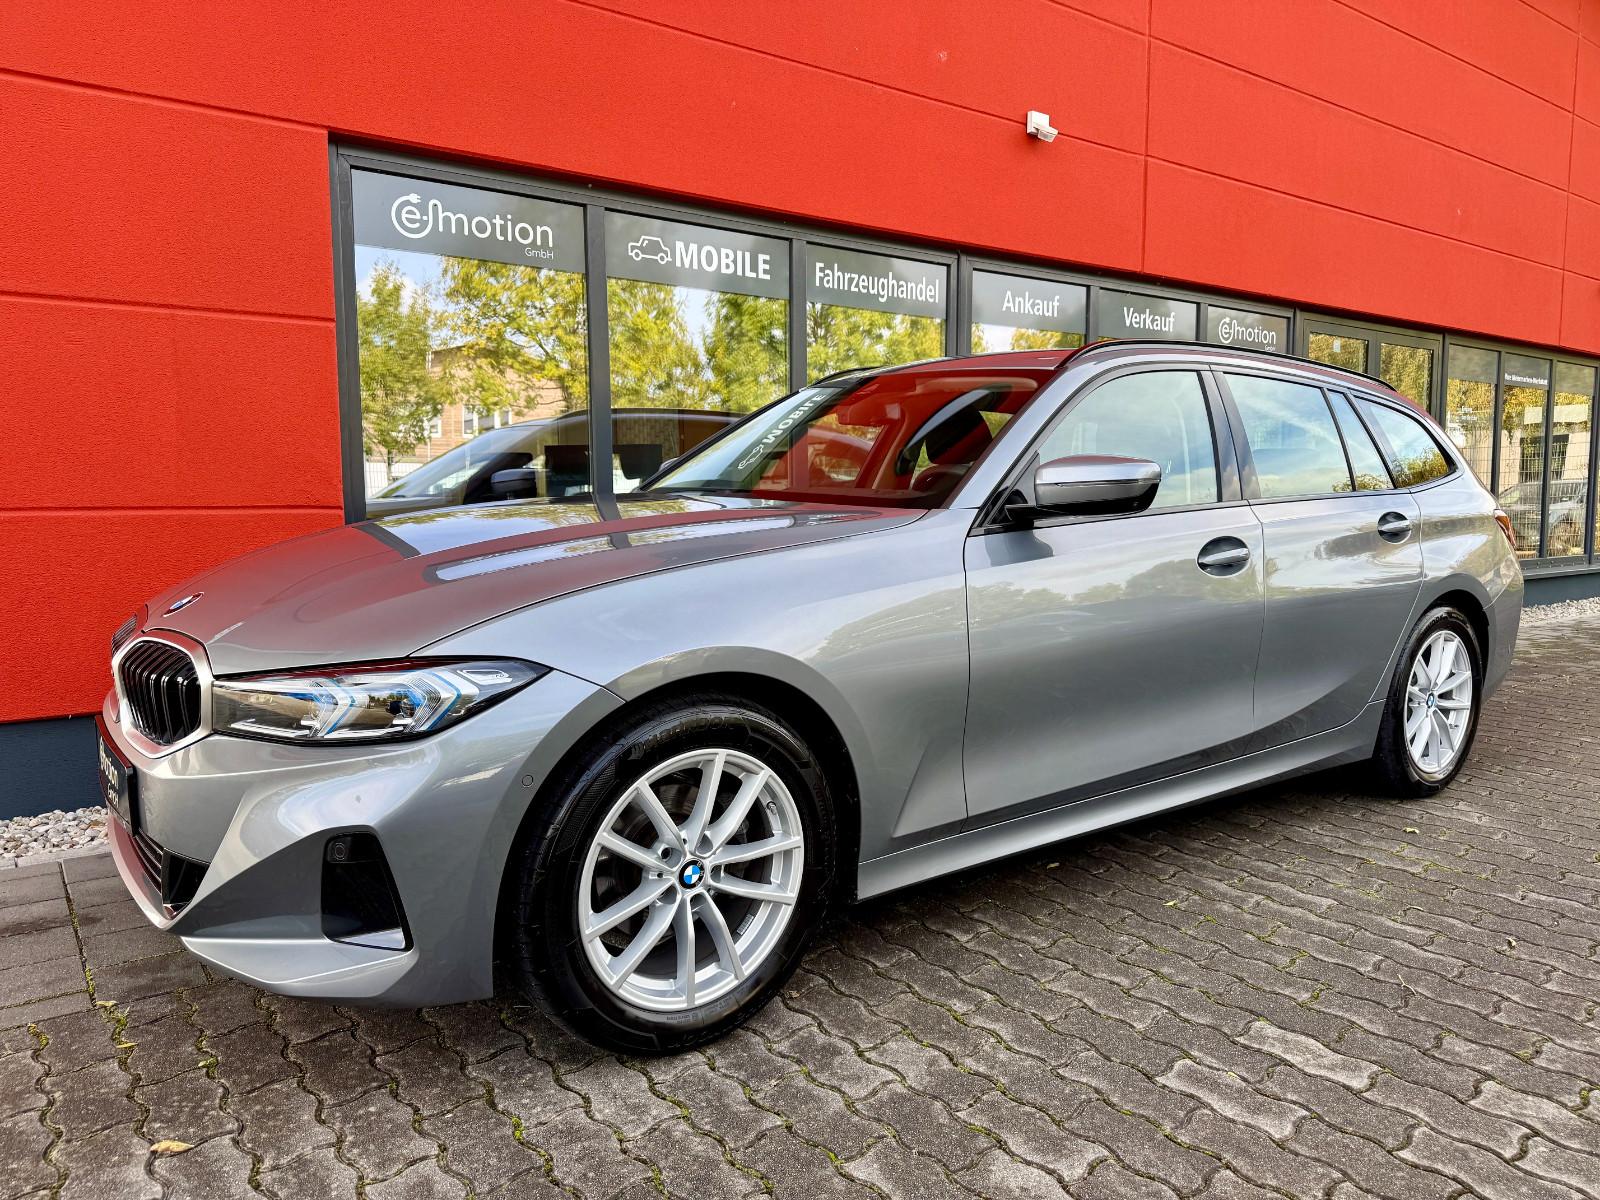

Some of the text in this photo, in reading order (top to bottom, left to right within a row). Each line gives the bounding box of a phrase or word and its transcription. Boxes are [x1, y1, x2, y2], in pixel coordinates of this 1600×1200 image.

[525, 247, 554, 260] GmbH
[675, 240, 771, 280] MOBILE
[815, 262, 939, 303] Fahrzeughandel
[1001, 290, 1060, 318] Ankauf
[1123, 306, 1176, 333] Verkauf
